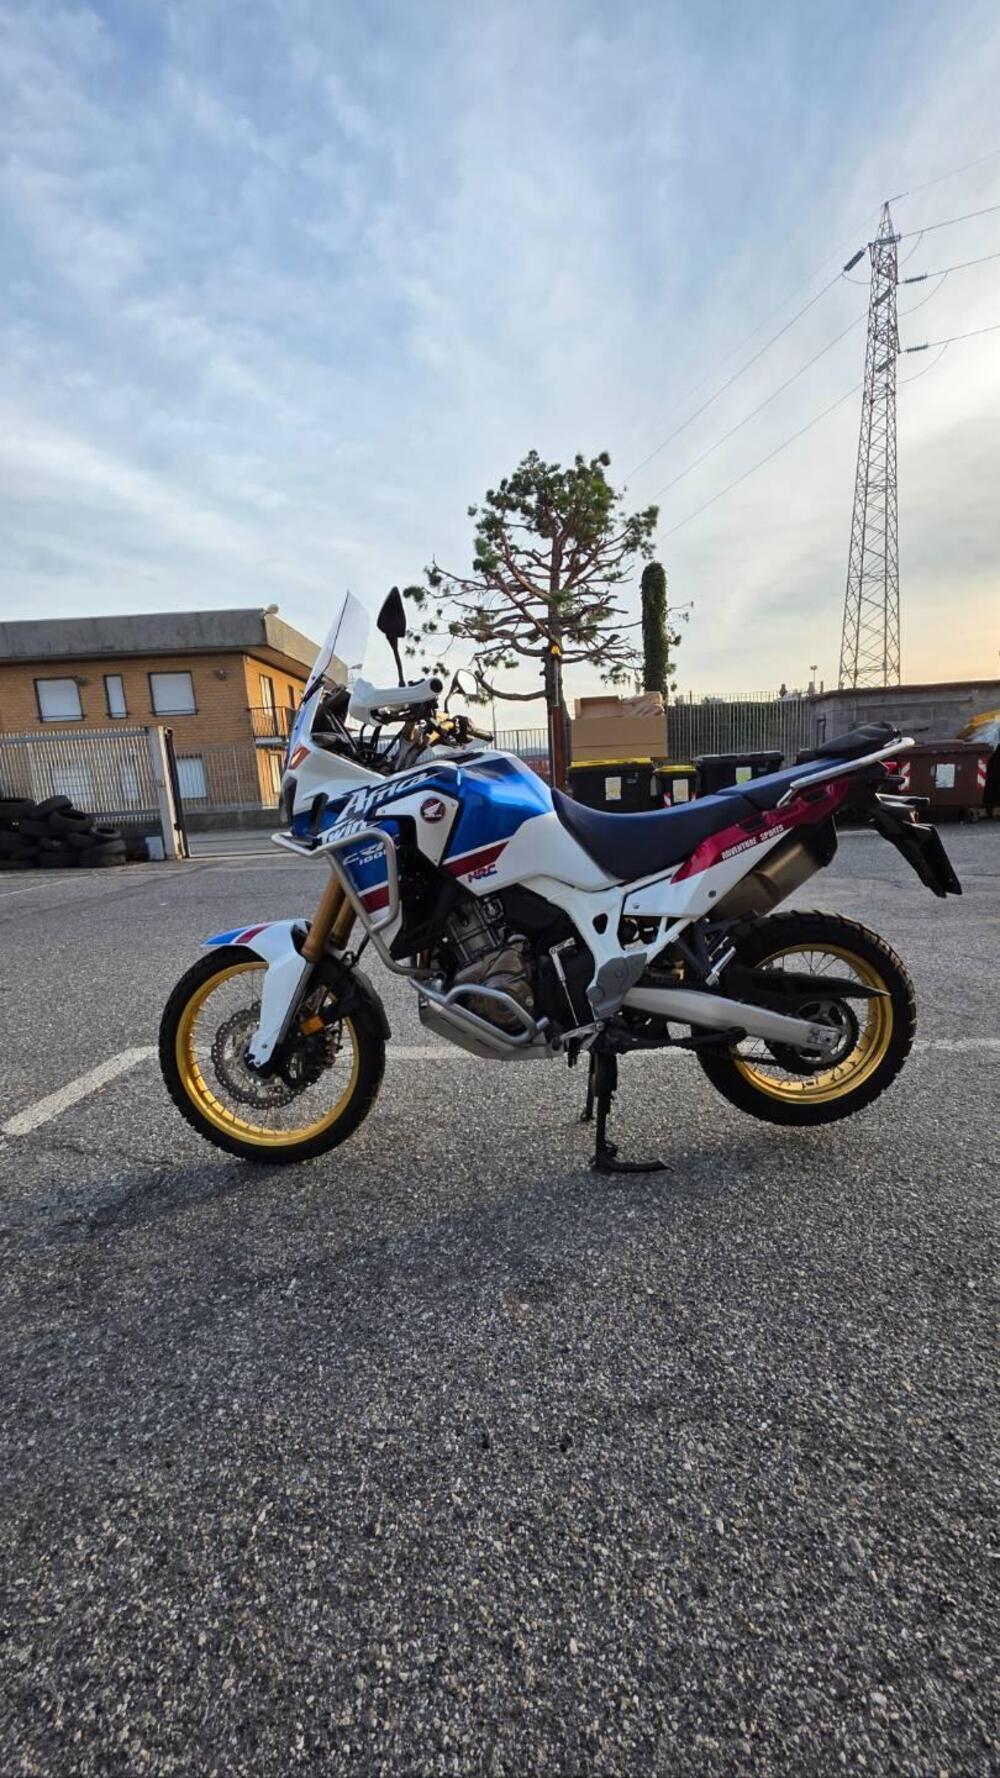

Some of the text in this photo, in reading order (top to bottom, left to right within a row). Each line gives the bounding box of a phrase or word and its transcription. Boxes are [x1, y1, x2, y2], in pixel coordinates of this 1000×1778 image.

[335, 773, 438, 823] Africa
[316, 818, 378, 846] Twin
[760, 824, 784, 841] SPORTS
